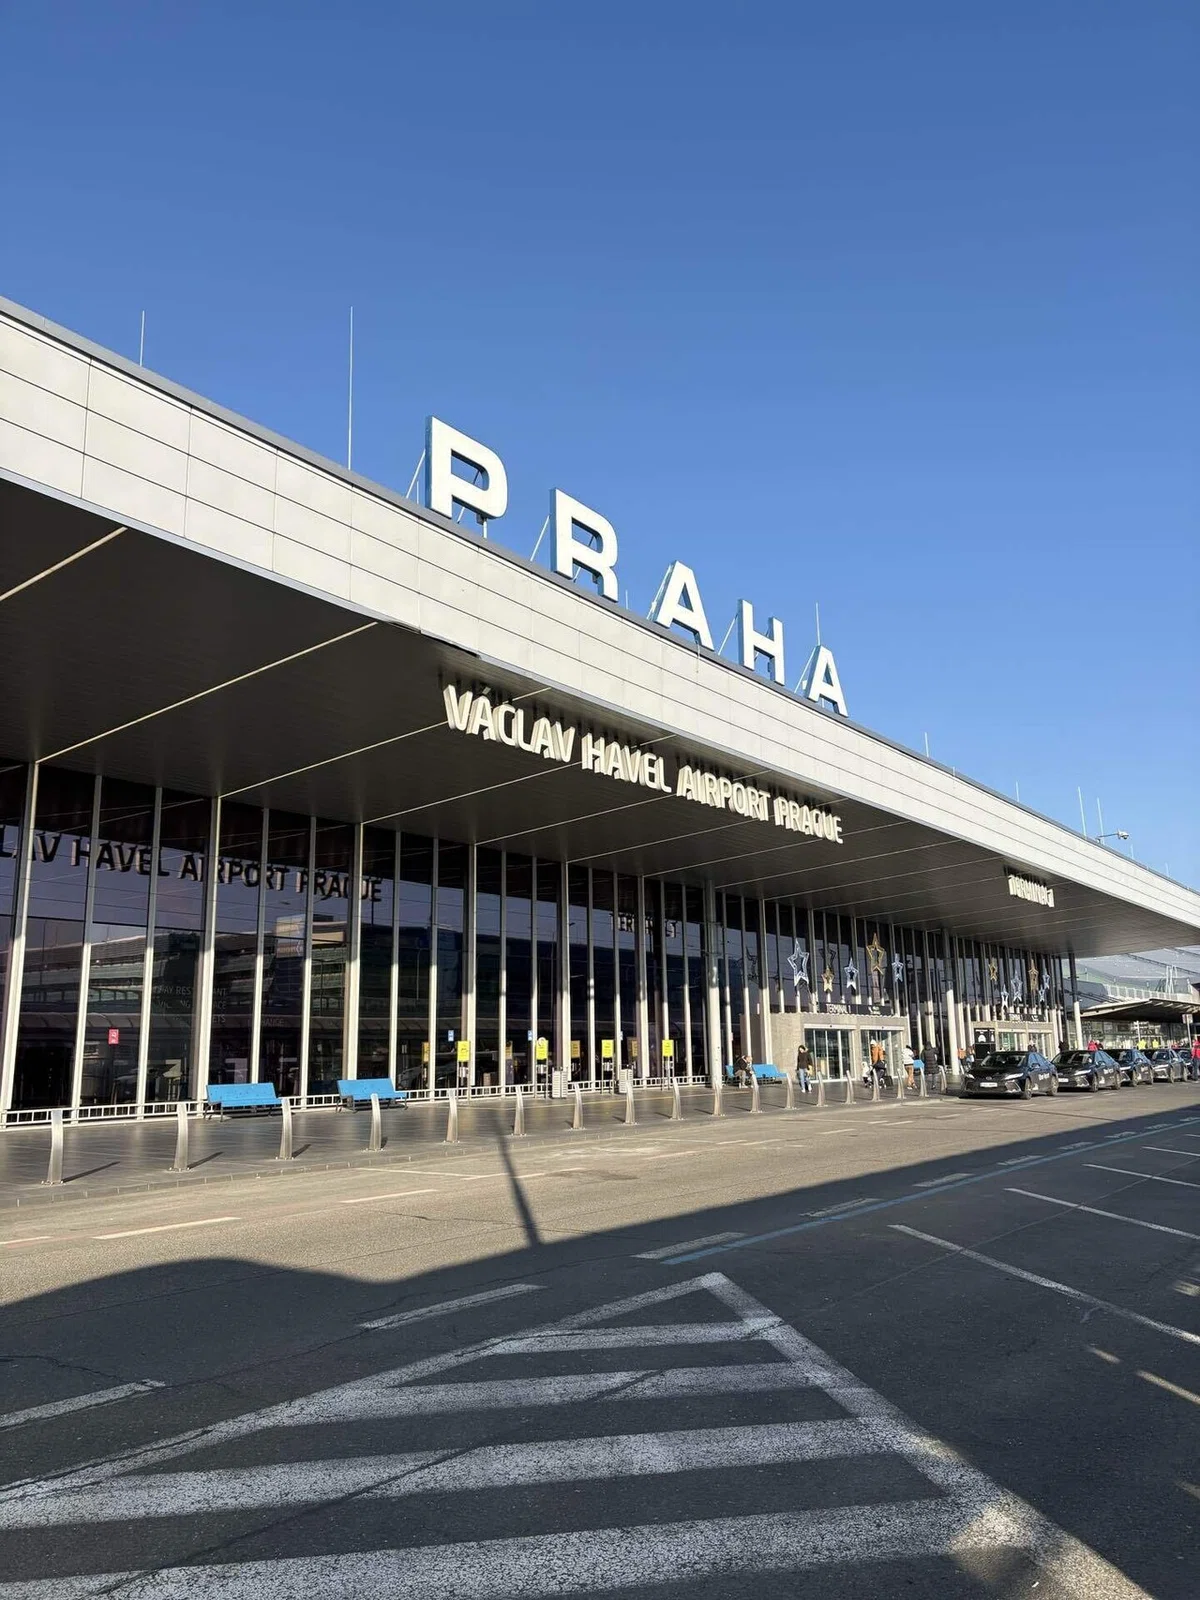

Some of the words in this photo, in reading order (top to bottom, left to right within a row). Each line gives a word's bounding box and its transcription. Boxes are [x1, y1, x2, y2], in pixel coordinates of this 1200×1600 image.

[425, 415, 848, 717] PRAHA
[443, 685, 576, 763] VÁCLAV
[581, 733, 672, 793] HAVEL
[676, 764, 771, 821] AIRPORT
[773, 796, 844, 844] PRAGUE
